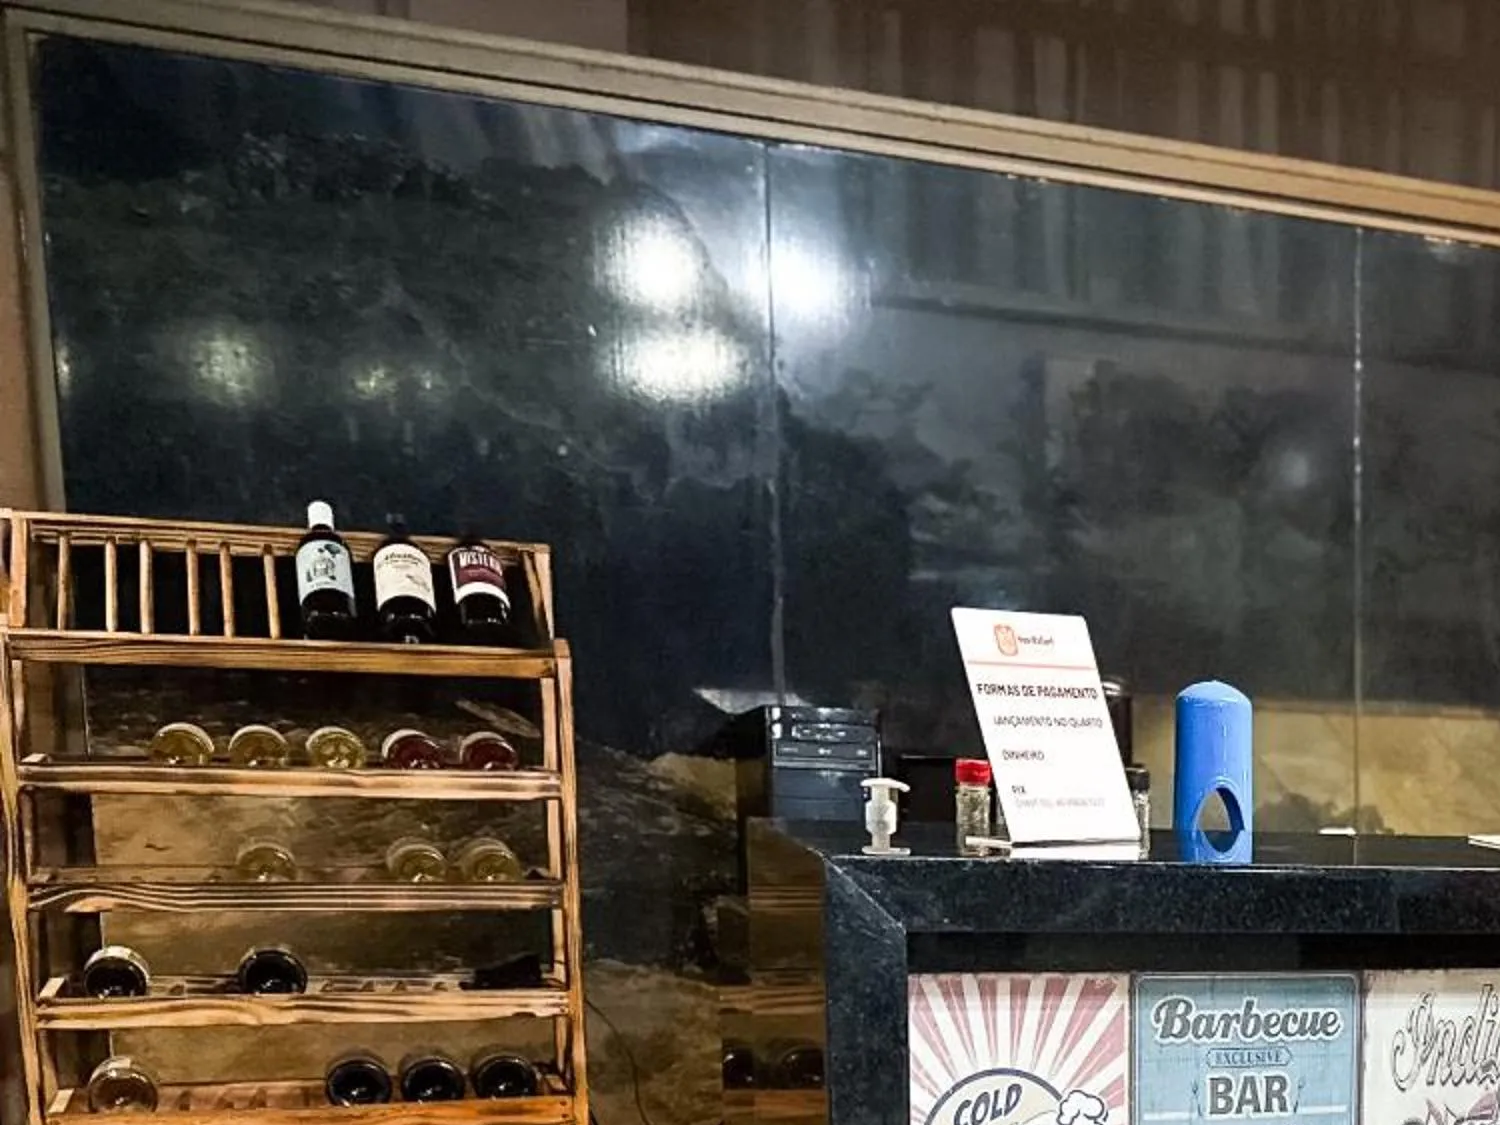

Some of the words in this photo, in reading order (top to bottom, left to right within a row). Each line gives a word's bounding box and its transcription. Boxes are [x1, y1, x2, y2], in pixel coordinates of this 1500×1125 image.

[976, 683, 1020, 697] FORMAS
[1021, 685, 1036, 697] DE
[1156, 997, 1340, 1041] Barbecue
[1214, 1050, 1282, 1067] EXCLUSIVE
[1208, 1075, 1289, 1116] BAR
